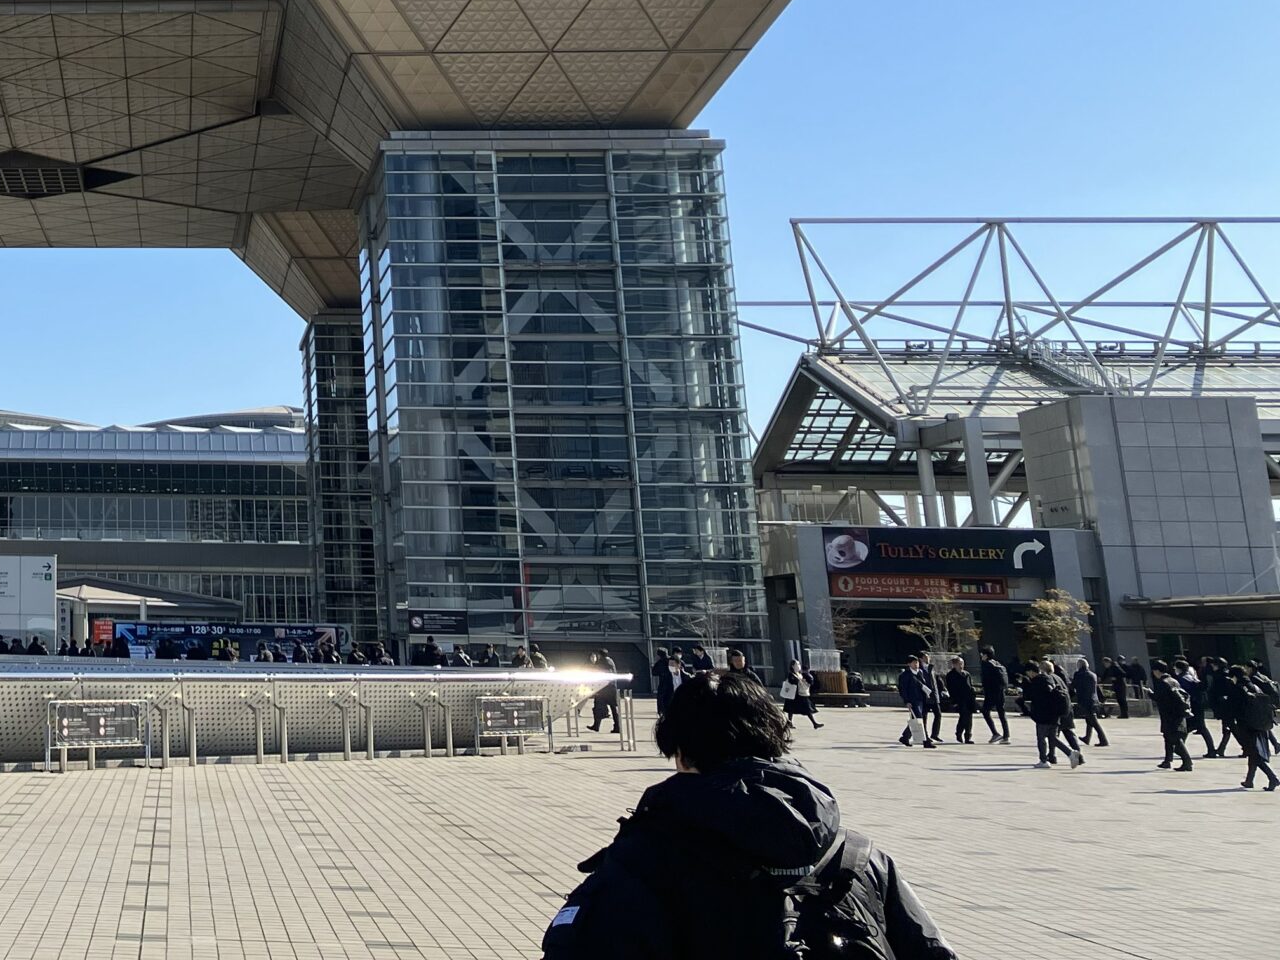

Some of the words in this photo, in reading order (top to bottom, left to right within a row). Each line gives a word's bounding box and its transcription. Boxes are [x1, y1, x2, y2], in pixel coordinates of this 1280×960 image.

[939, 547, 1007, 559] GALLERY
[855, 577, 879, 585] FOOD
[881, 577, 910, 585] COURT
